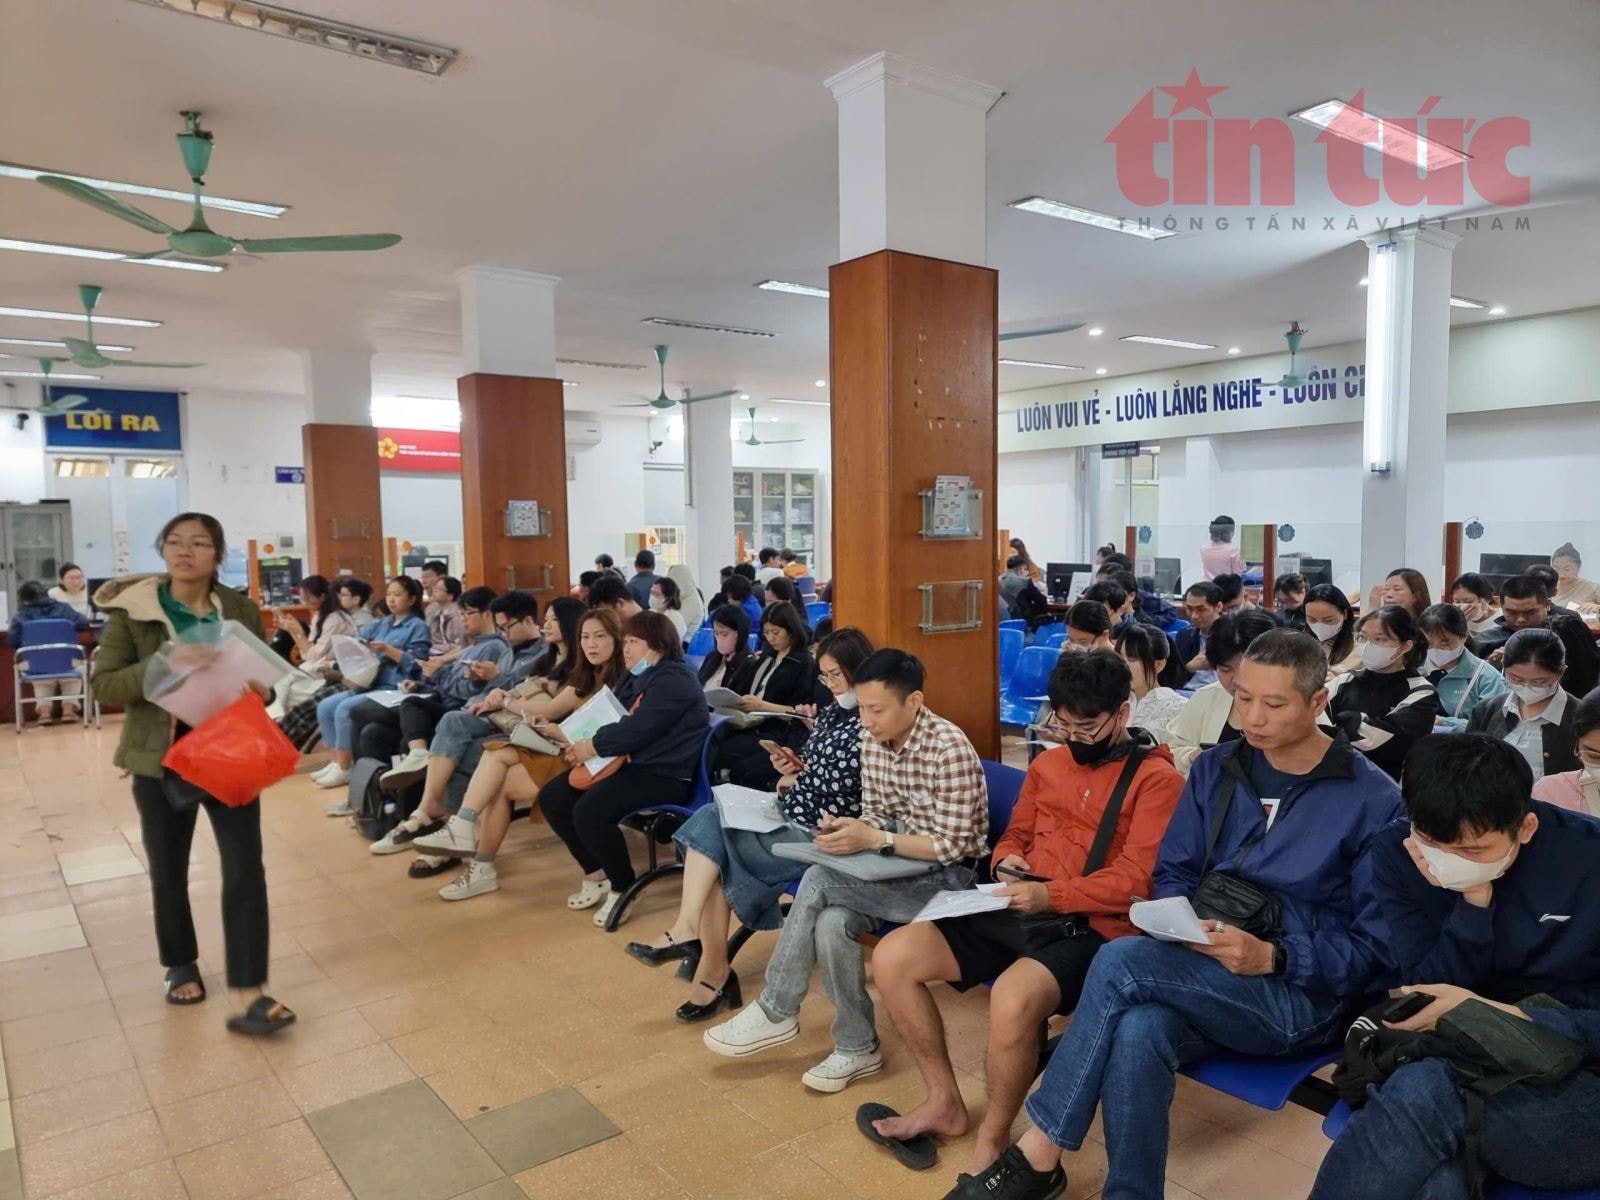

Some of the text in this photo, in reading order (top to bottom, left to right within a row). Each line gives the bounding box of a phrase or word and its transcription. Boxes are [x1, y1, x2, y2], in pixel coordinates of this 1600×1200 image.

[1017, 401, 1052, 433] LUÔN
[1055, 401, 1079, 429] VUI
[1082, 388, 1101, 426] VẺ
[1116, 388, 1157, 422] LUÔN
[1162, 379, 1207, 417] LẮNG
[1212, 377, 1263, 412] NGHE
[1282, 365, 1337, 404] LUÔN
[120, 413, 161, 432] RA
